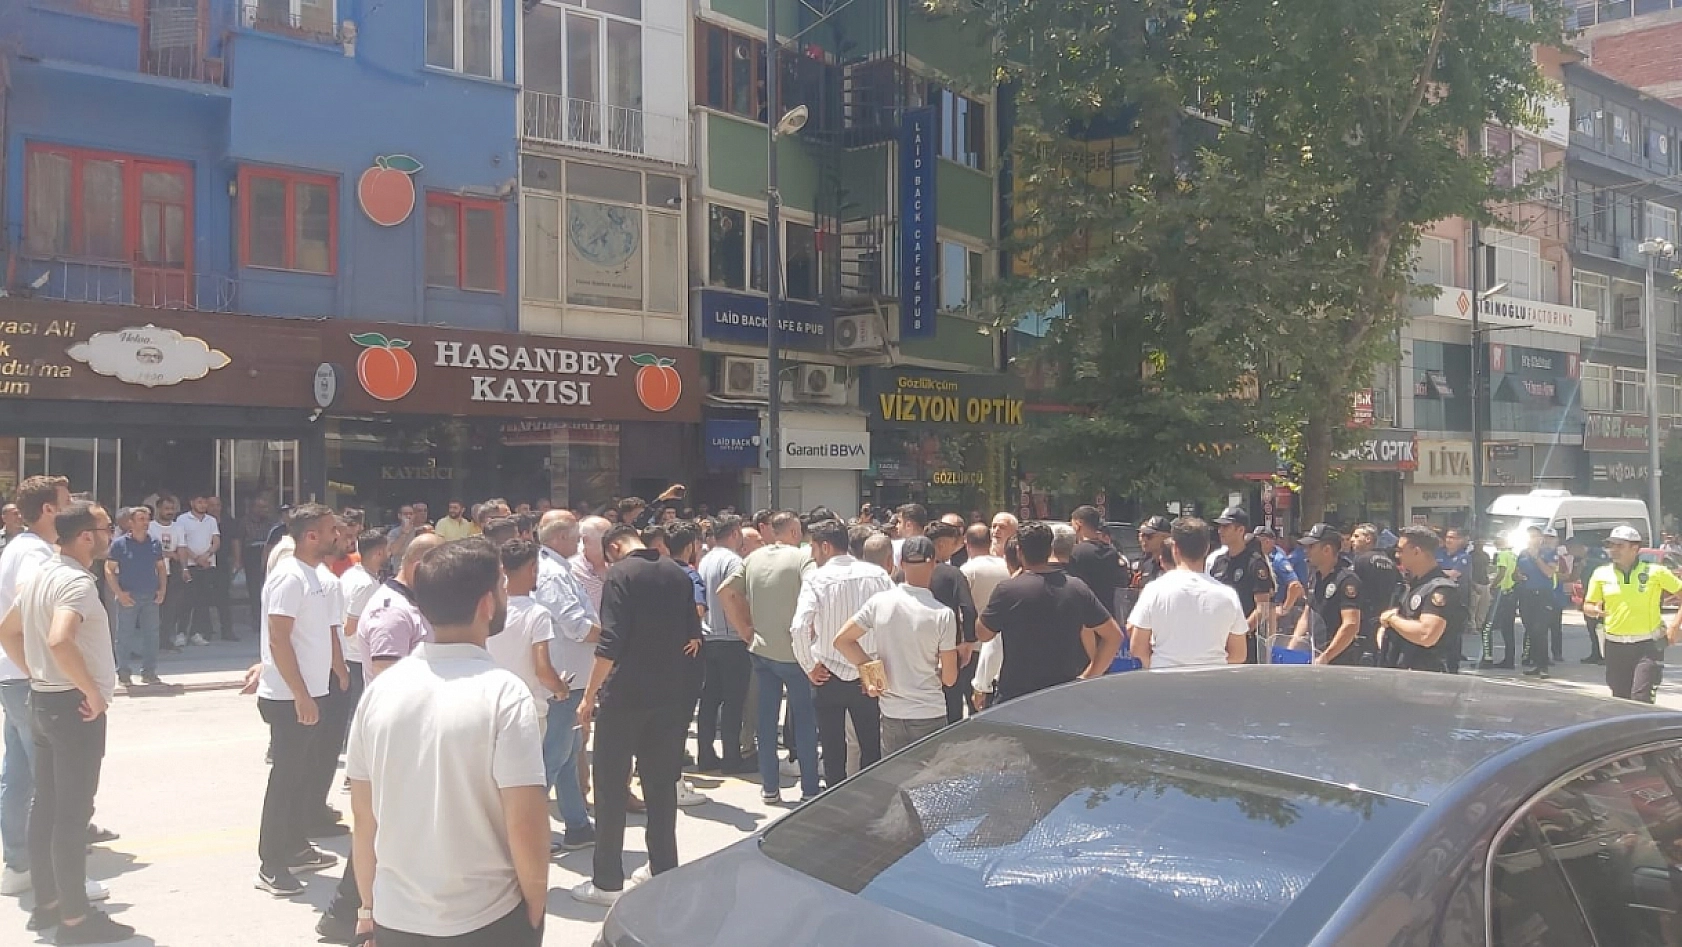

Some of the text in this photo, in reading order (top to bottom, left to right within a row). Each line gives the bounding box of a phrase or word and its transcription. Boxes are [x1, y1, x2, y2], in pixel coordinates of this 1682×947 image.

[914, 175, 922, 222] BACK
[914, 229, 922, 276] CAFE
[741, 314, 769, 328] BACK
[796, 321, 804, 332] &
[804, 322, 824, 335] PUB
[914, 295, 922, 330] PUB
[44, 320, 76, 337] Ali
[434, 340, 623, 377] HASANBEY
[471, 376, 591, 406] KAYISI
[898, 376, 958, 391] Gözlükçüm
[880, 388, 1024, 425] VİZYON OPTİK
[731, 438, 750, 447] BACK
[786, 442, 865, 457] Garanti BBVA
[1429, 446, 1471, 477] LİVA
